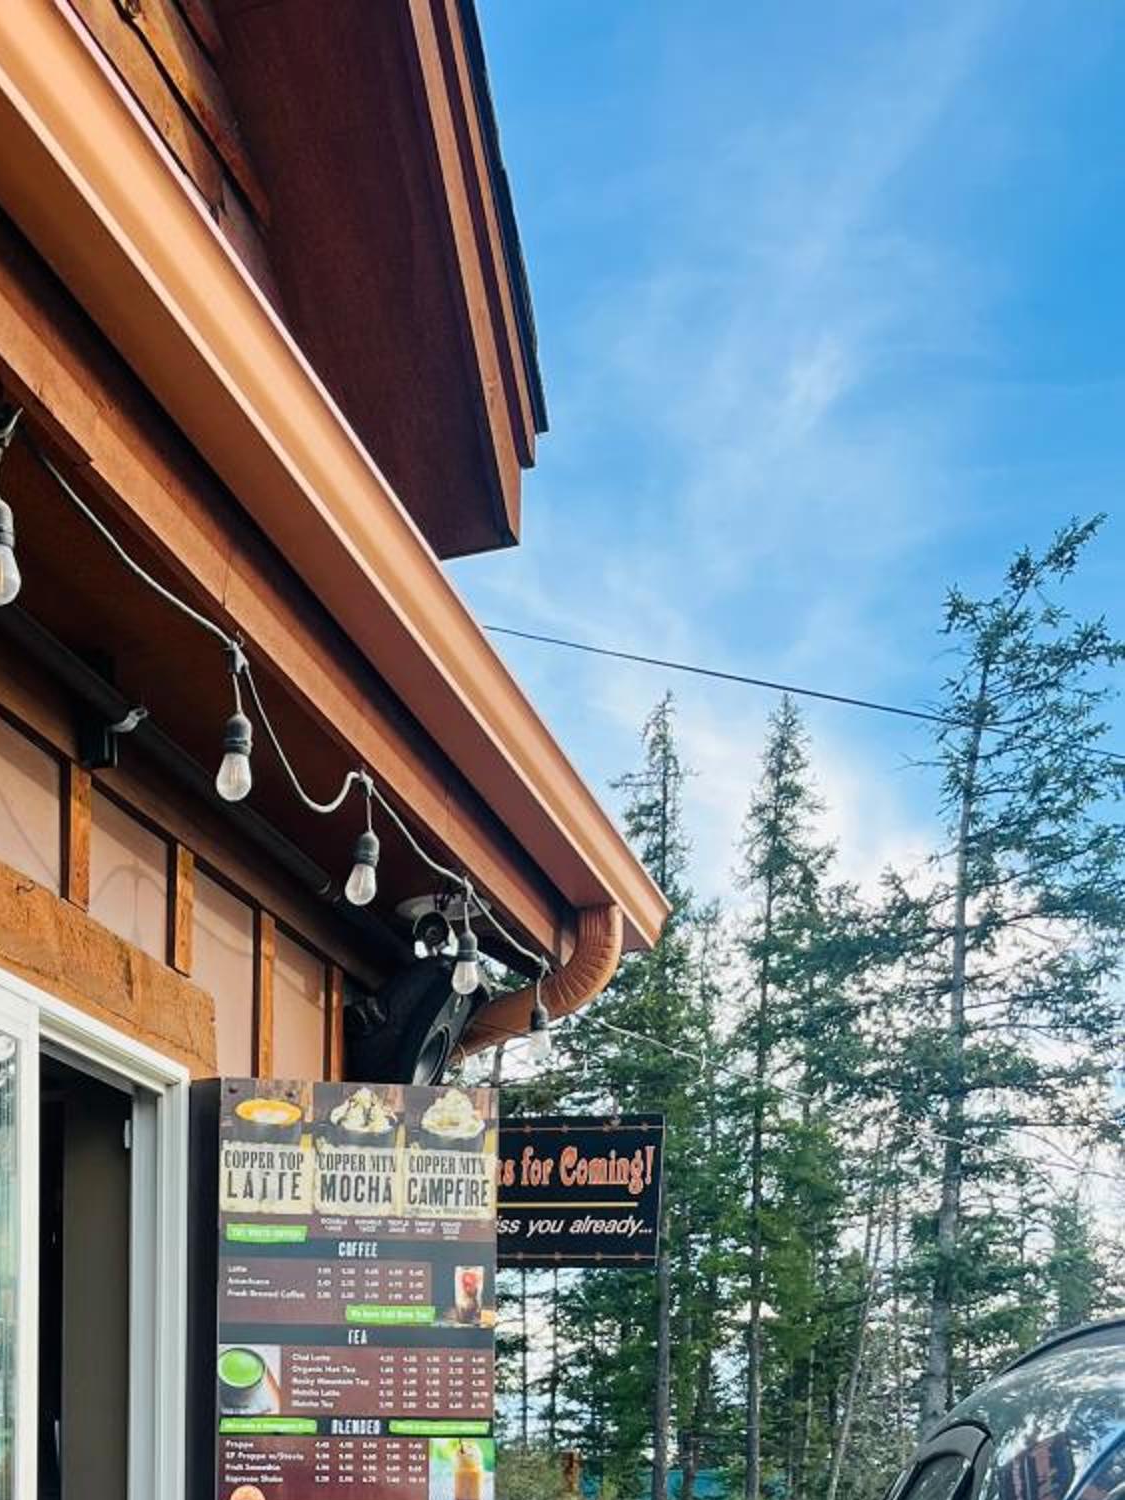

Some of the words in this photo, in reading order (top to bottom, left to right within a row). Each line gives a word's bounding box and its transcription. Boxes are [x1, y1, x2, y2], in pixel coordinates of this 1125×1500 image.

[224, 1149, 274, 1169] COPPER
[278, 1150, 304, 1169] TOP
[318, 1152, 366, 1172] COPPER
[371, 1154, 396, 1173] MTN
[409, 1154, 456, 1174] COPPER
[459, 1156, 486, 1175] MTN
[521, 1146, 554, 1186] for
[560, 1145, 656, 1195] Coming!
[227, 1171, 302, 1200] LATTE
[320, 1173, 392, 1203] MOCHA
[407, 1176, 490, 1207] CAMPFIRE
[526, 1219, 563, 1238] you
[338, 1241, 378, 1258] COFFEE
[348, 1328, 368, 1345] TEA
[331, 1419, 380, 1435] BLENDED
